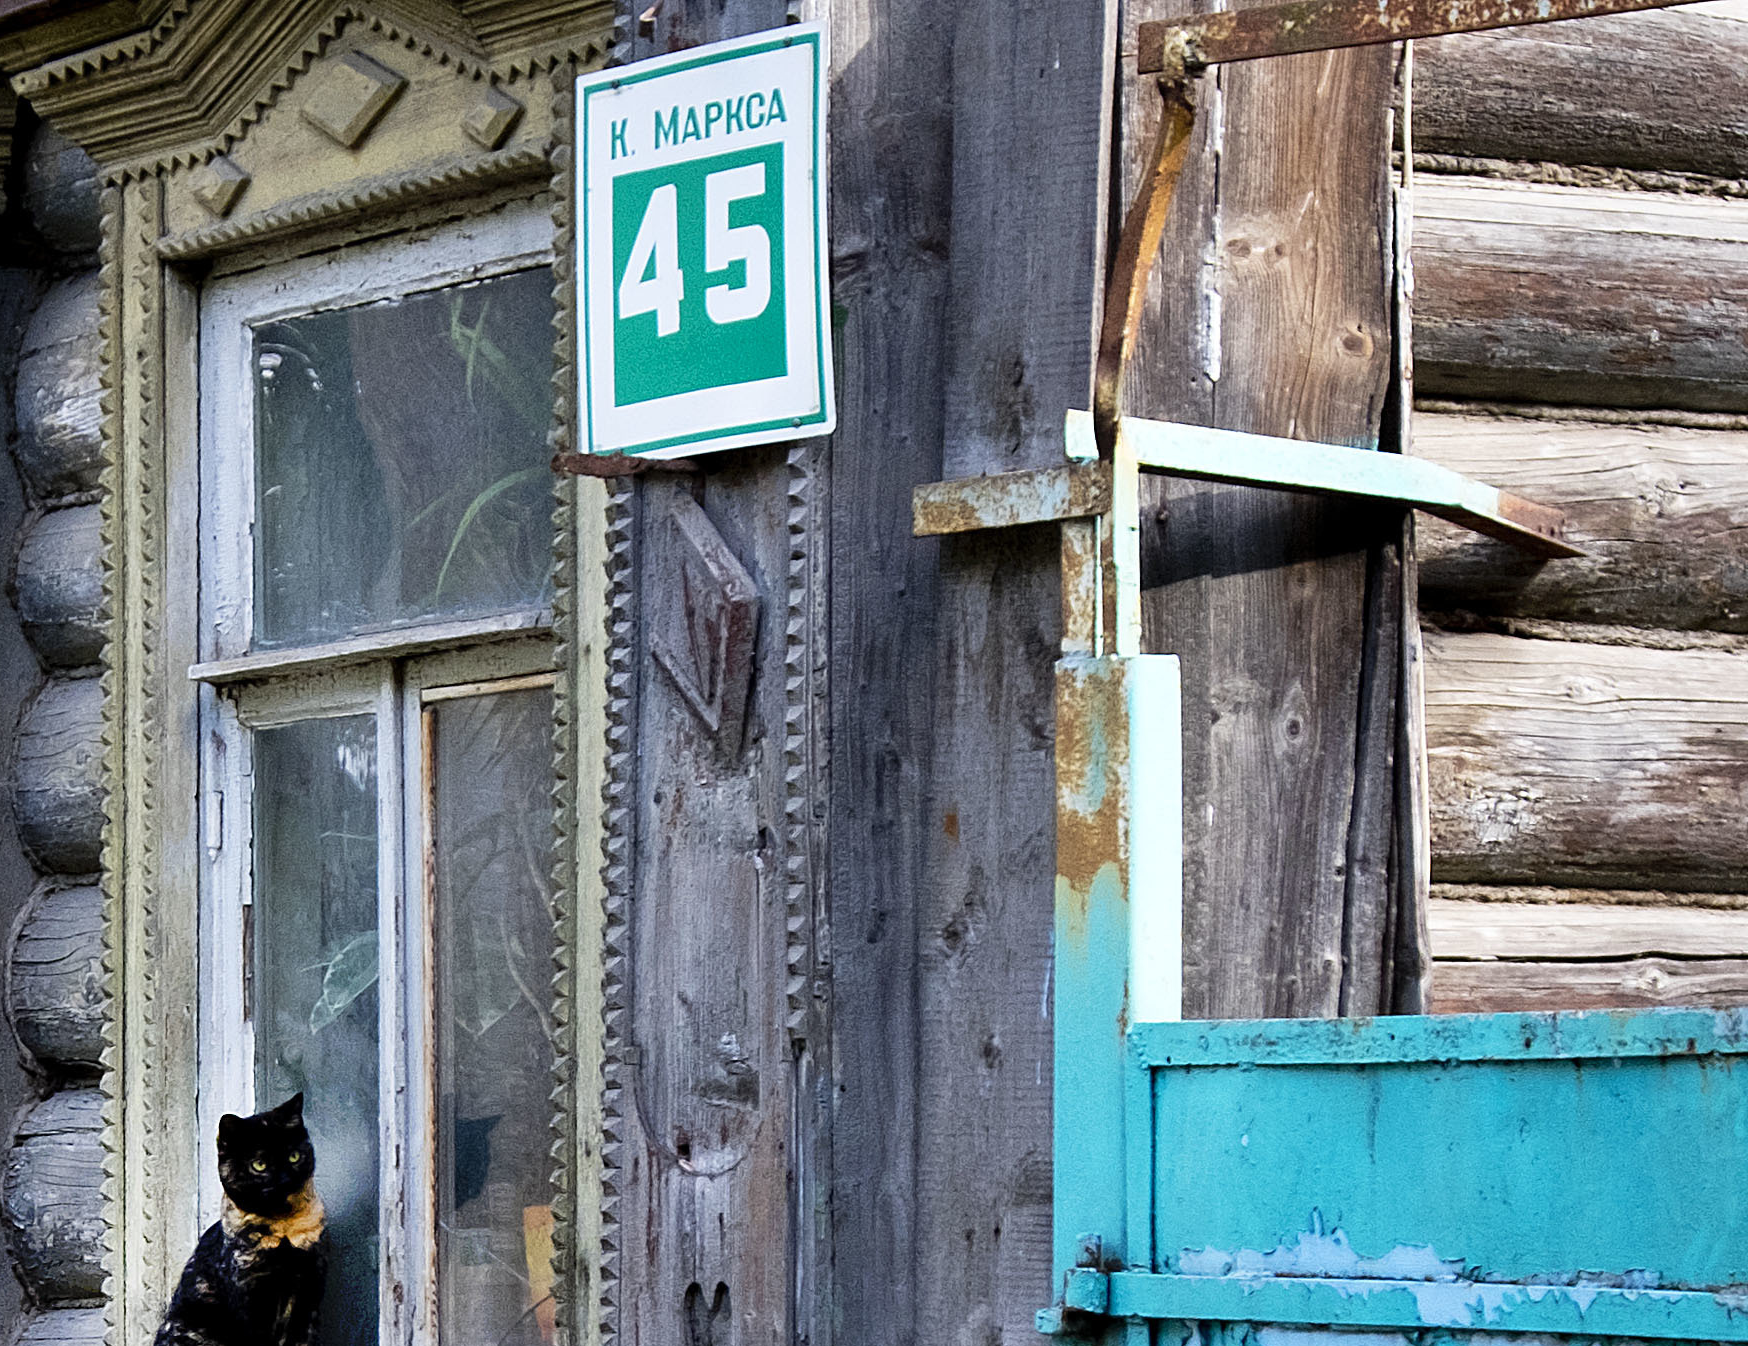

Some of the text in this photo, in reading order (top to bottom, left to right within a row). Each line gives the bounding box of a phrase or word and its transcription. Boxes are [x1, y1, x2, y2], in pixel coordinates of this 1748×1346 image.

[610, 87, 788, 160] К. МАРКСА
[618, 161, 772, 338] 45
